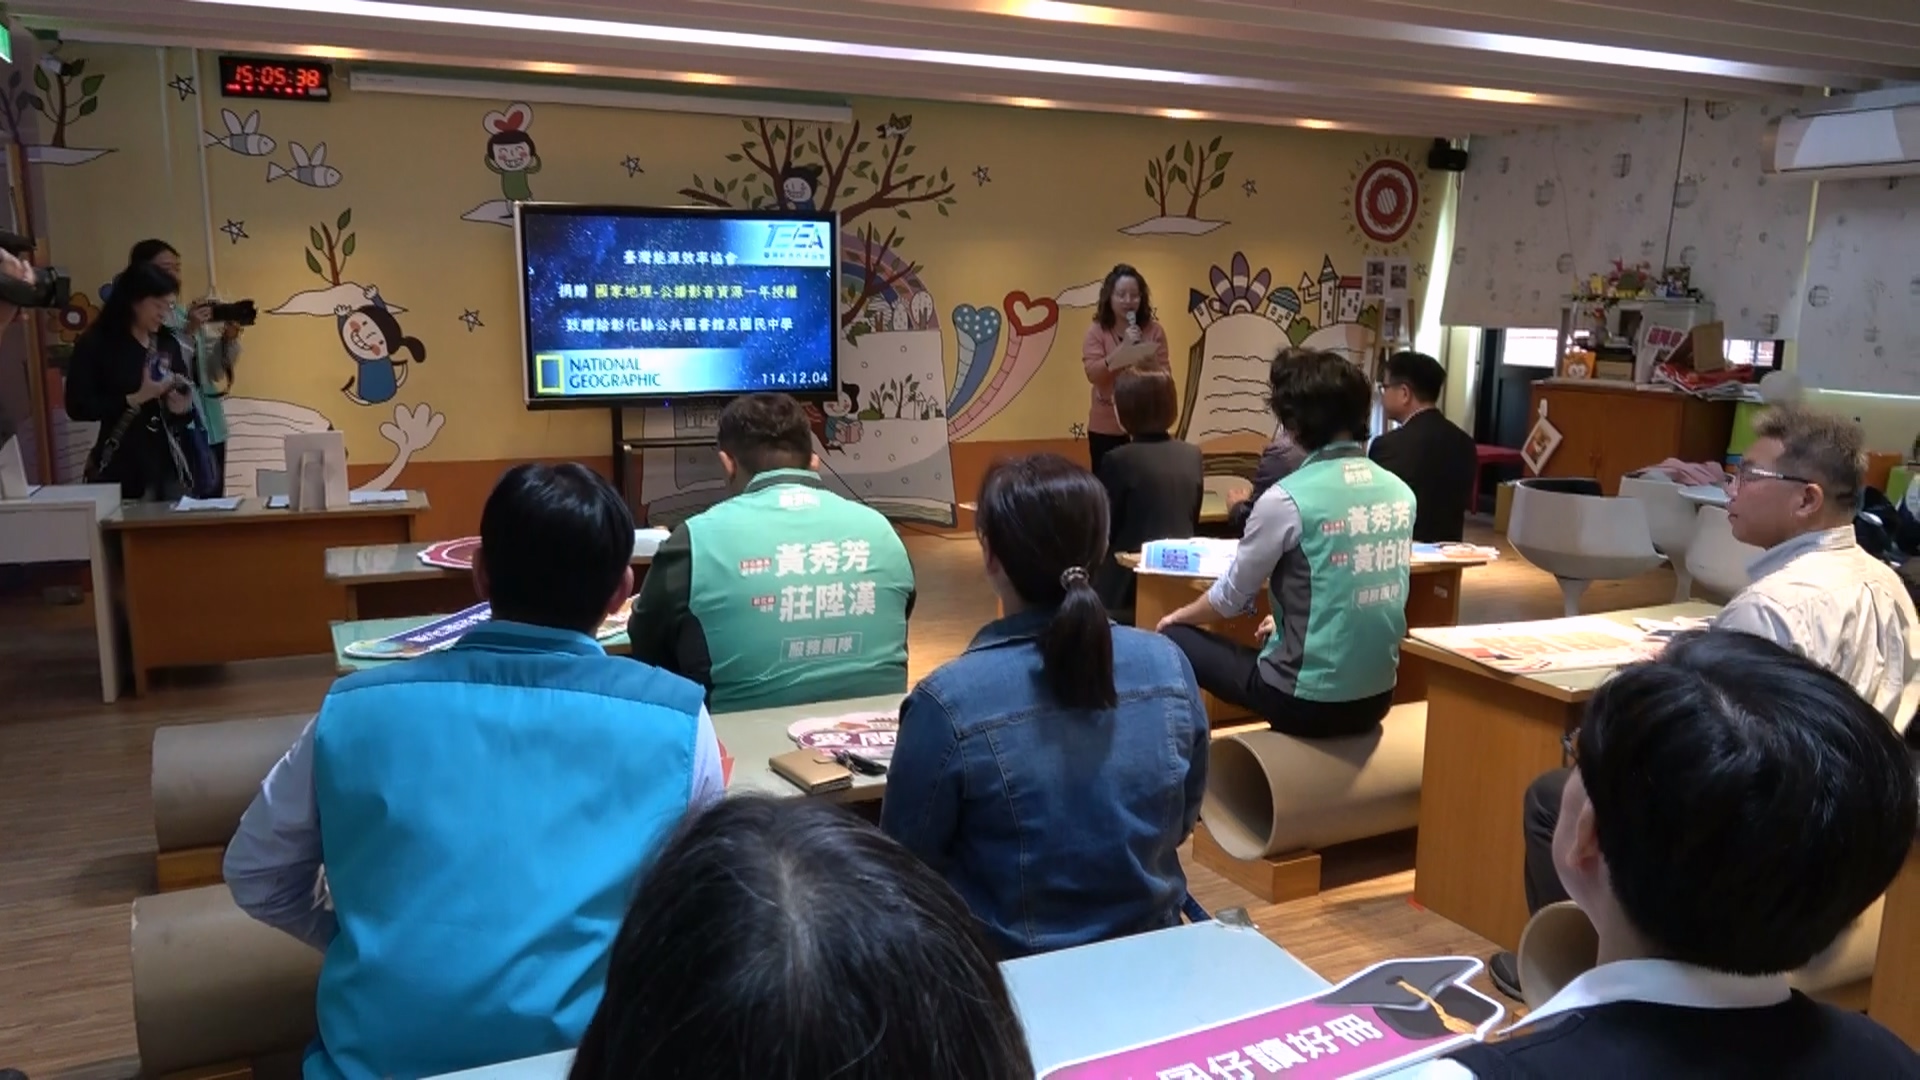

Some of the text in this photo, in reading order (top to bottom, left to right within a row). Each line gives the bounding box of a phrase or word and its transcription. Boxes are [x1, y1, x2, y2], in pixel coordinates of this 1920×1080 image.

[234, 65, 321, 87] 15:05:38
[569, 358, 641, 371] NATIONAL
[569, 374, 661, 388] GEOGRAPHIC
[762, 372, 829, 386] 114.12.04
[1347, 501, 1411, 537] 黃秀芳
[775, 540, 872, 577] 黃秀芳
[779, 581, 877, 623] 莊陞漢
